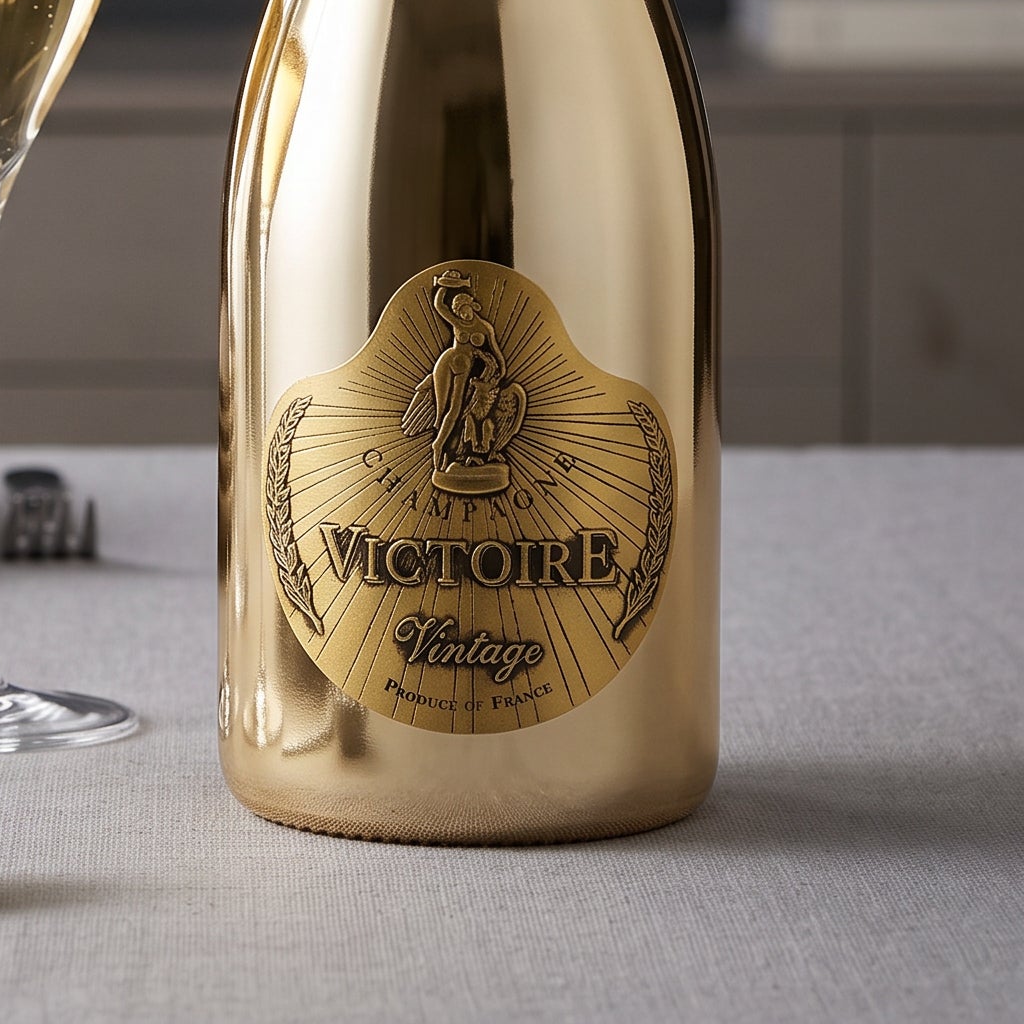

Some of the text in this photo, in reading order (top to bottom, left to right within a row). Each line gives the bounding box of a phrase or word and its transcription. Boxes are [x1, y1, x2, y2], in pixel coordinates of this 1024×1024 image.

[319, 522, 618, 588] VICTOIRE
[394, 616, 544, 682] Vintage
[383, 678, 553, 712] PRODUCE OF FRANCE
